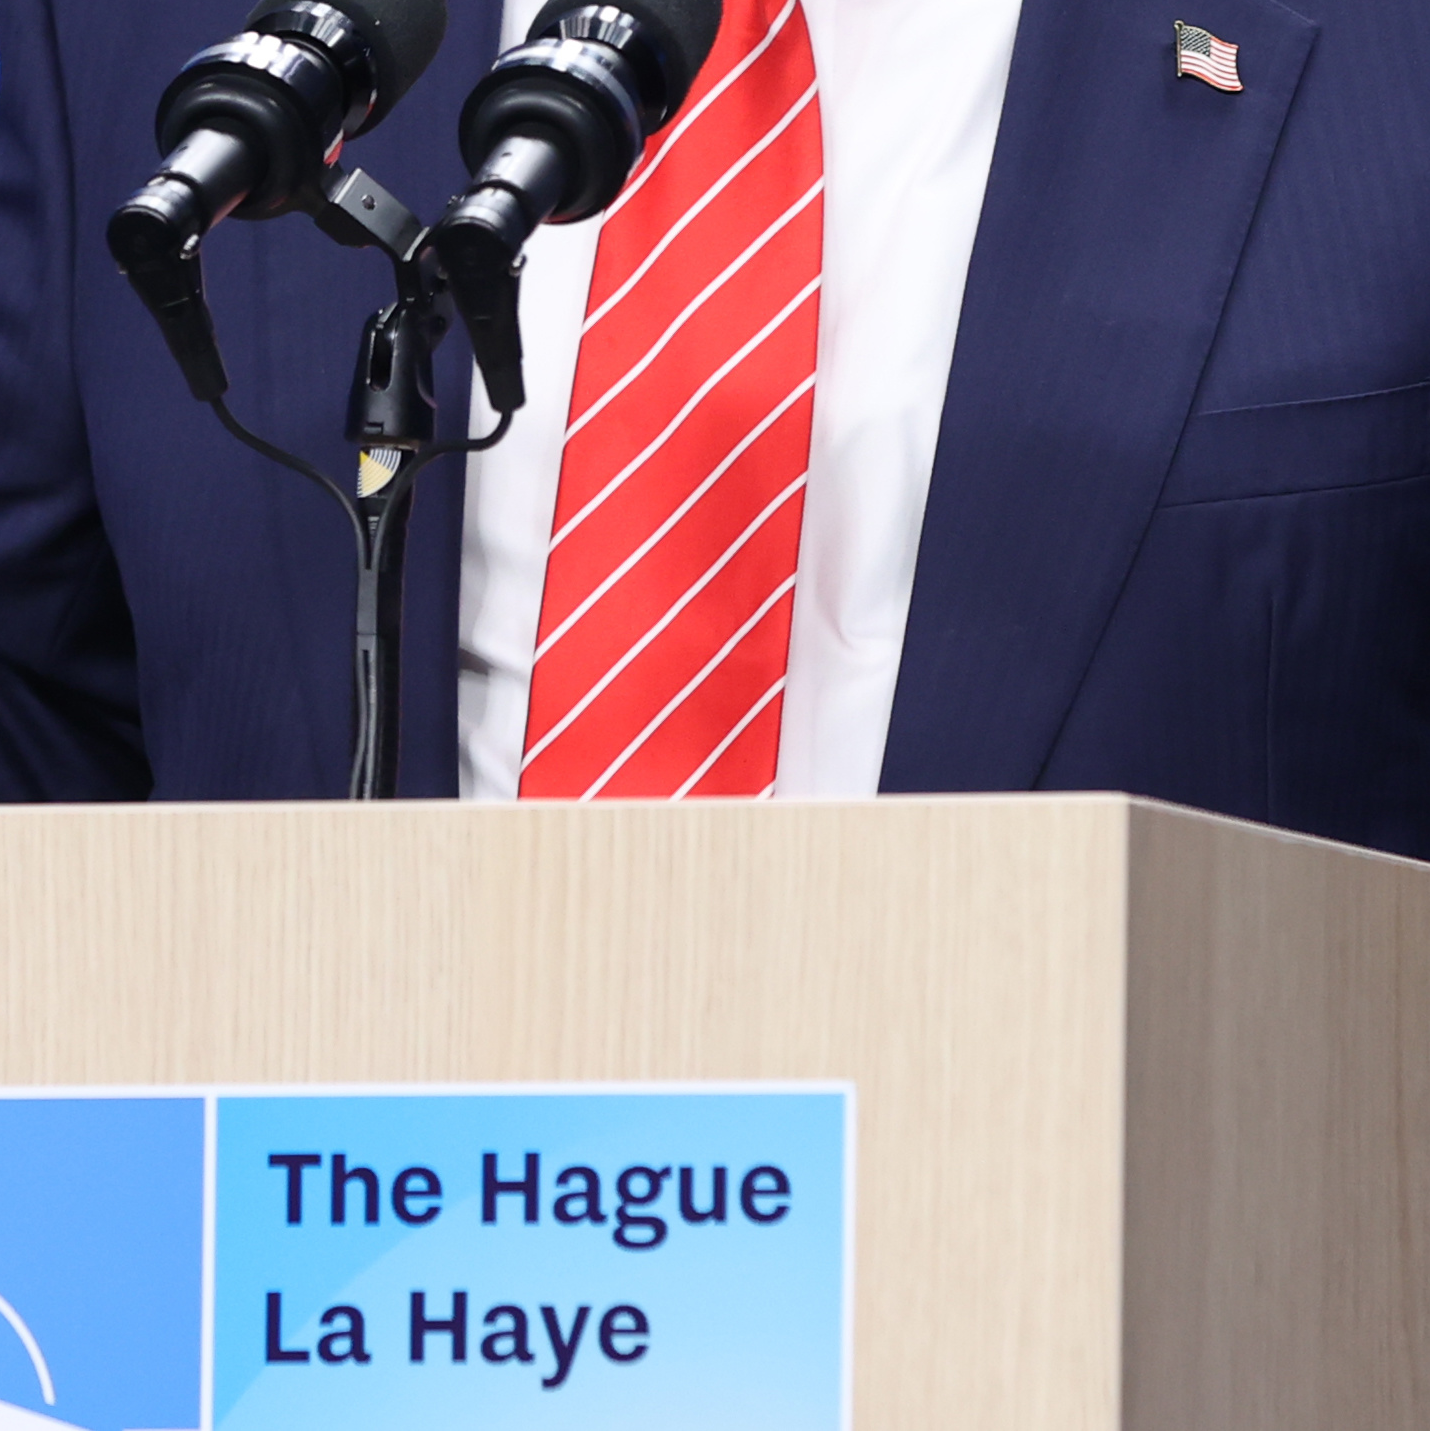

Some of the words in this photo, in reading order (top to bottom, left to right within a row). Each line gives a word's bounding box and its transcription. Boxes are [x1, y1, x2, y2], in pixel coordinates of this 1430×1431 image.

[268, 1152, 443, 1226] The
[481, 1151, 792, 1251] Hague
[266, 1291, 372, 1365] La
[410, 1291, 650, 1390] Haye
